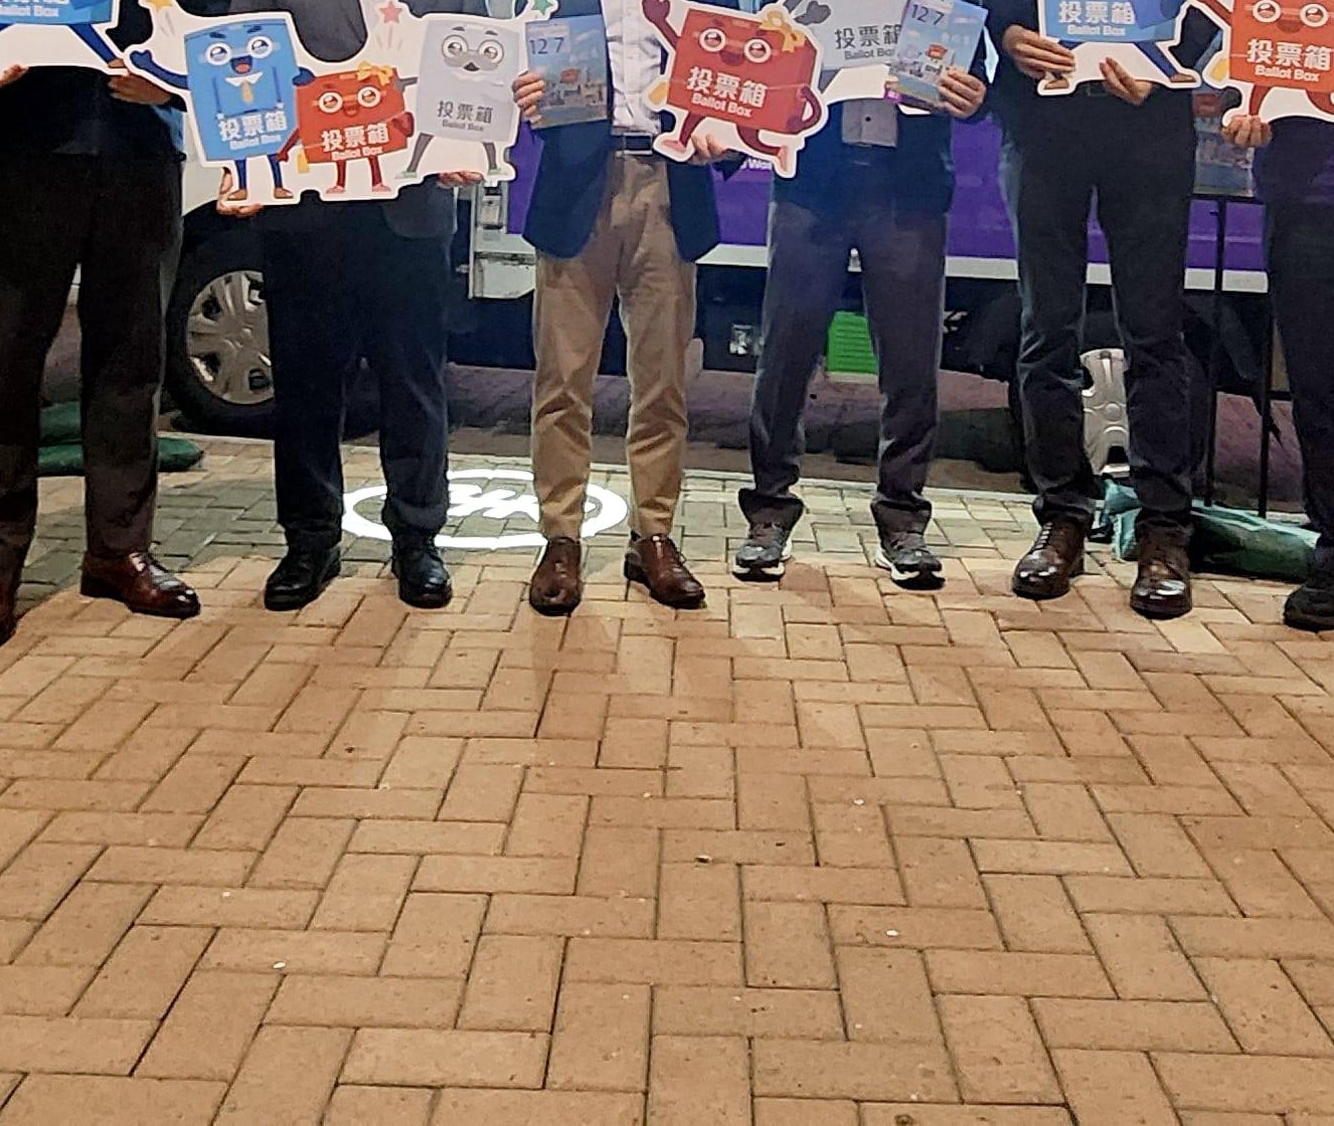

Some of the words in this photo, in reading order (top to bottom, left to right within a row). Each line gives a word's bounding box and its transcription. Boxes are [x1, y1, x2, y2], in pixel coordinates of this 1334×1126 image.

[1058, 0, 1135, 25] 投票箱
[844, 48, 874, 61] Ballot
[1246, 38, 1333, 72] 投票箱
[1253, 63, 1291, 79] Ballot
[1293, 69, 1320, 83] Box
[686, 65, 768, 108] 投票箱
[437, 100, 494, 124] 投票箱
[690, 92, 727, 112] Ballot
[727, 101, 753, 118] Box
[220, 110, 288, 142] 投票箱
[320, 122, 390, 153] 投票箱
